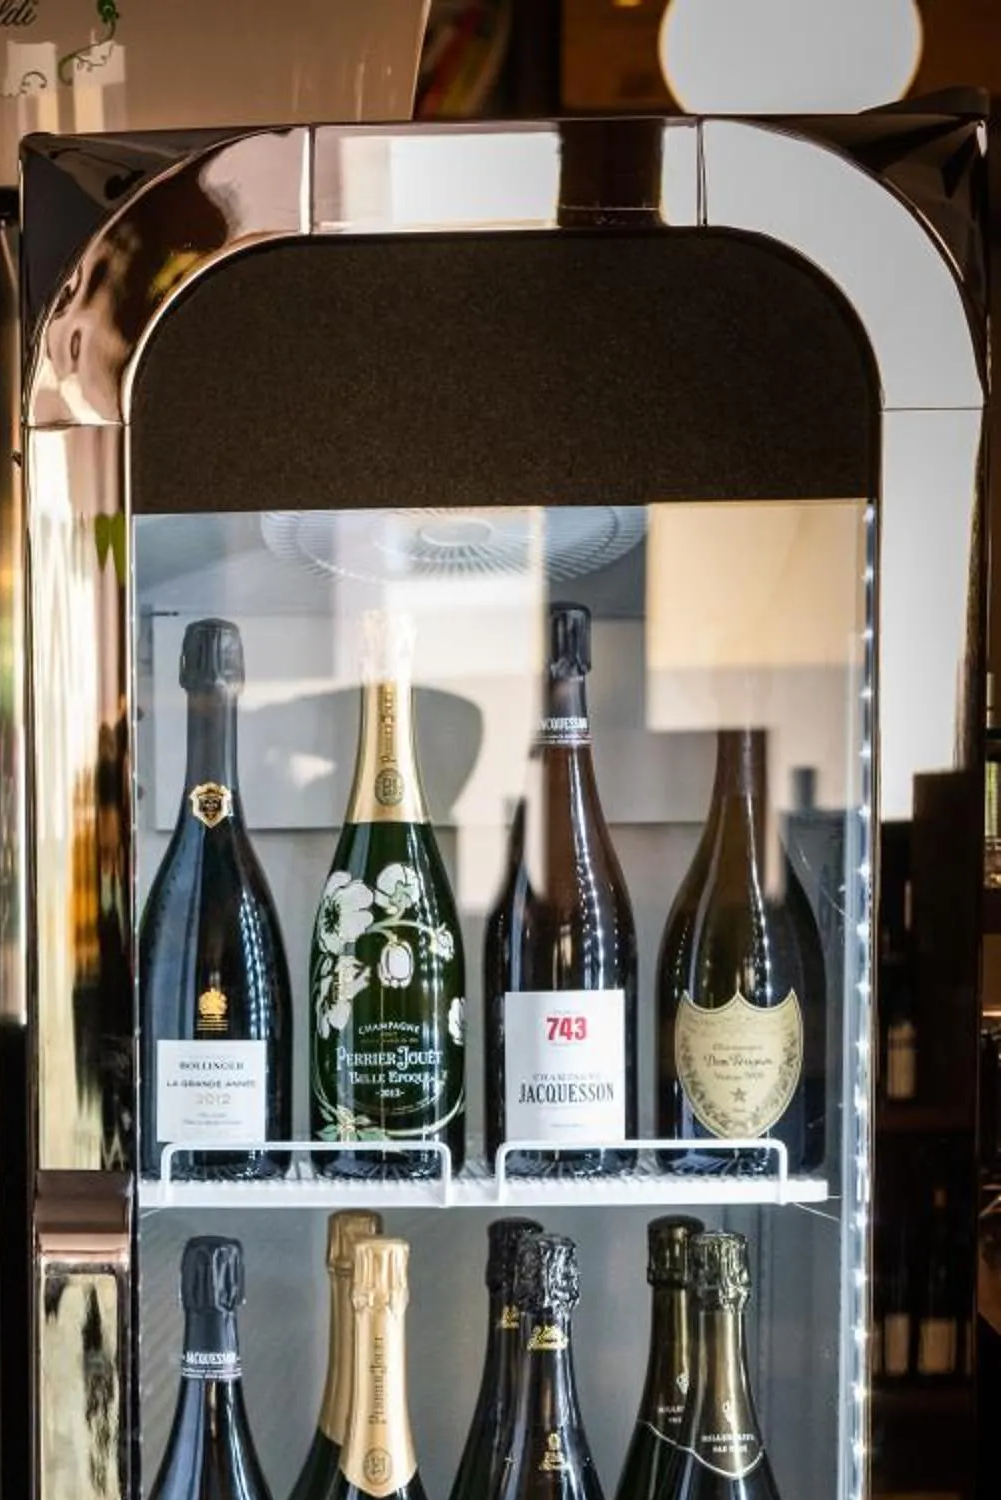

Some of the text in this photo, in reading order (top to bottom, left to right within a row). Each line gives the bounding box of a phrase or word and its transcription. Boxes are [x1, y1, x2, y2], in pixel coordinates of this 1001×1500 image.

[358, 1021, 420, 1034] CHAMPAGNE
[546, 1016, 588, 1041] 743
[179, 1061, 244, 1070] BOLLINGER
[349, 1071, 386, 1084] BELLE
[181, 1080, 224, 1089] GRANDE
[518, 1082, 615, 1104] JACQUESSON
